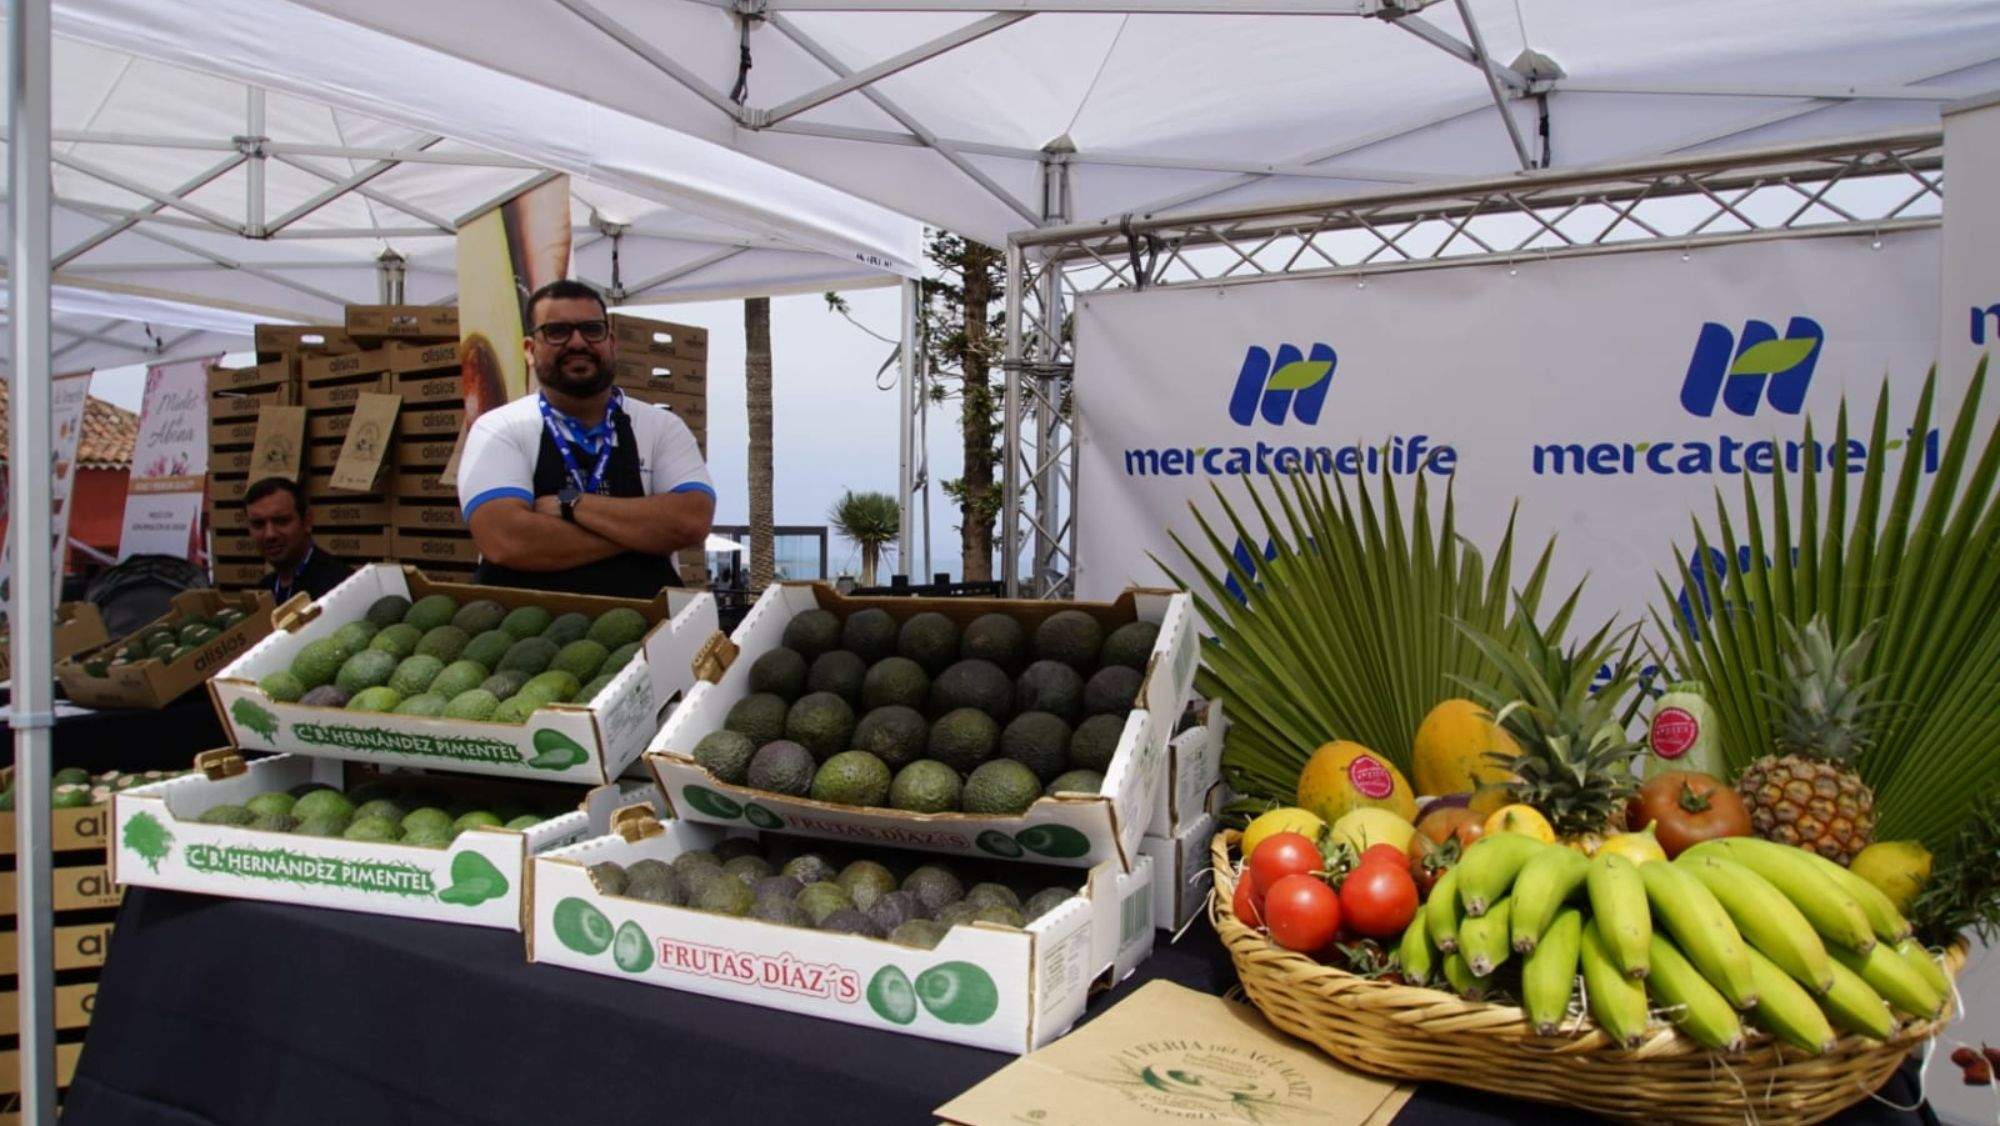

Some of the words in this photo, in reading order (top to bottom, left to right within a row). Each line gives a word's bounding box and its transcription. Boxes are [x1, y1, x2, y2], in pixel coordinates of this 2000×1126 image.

[1125, 434, 1458, 476] mercatenerife
[194, 632, 247, 671] alisios
[332, 730, 432, 751] HERNÁNDEZ
[436, 741, 520, 761] PIMENTEL
[228, 853, 336, 881] HERNÁNDEZ
[342, 863, 430, 891] PIMENTEL
[661, 943, 754, 979] FRUTAS
